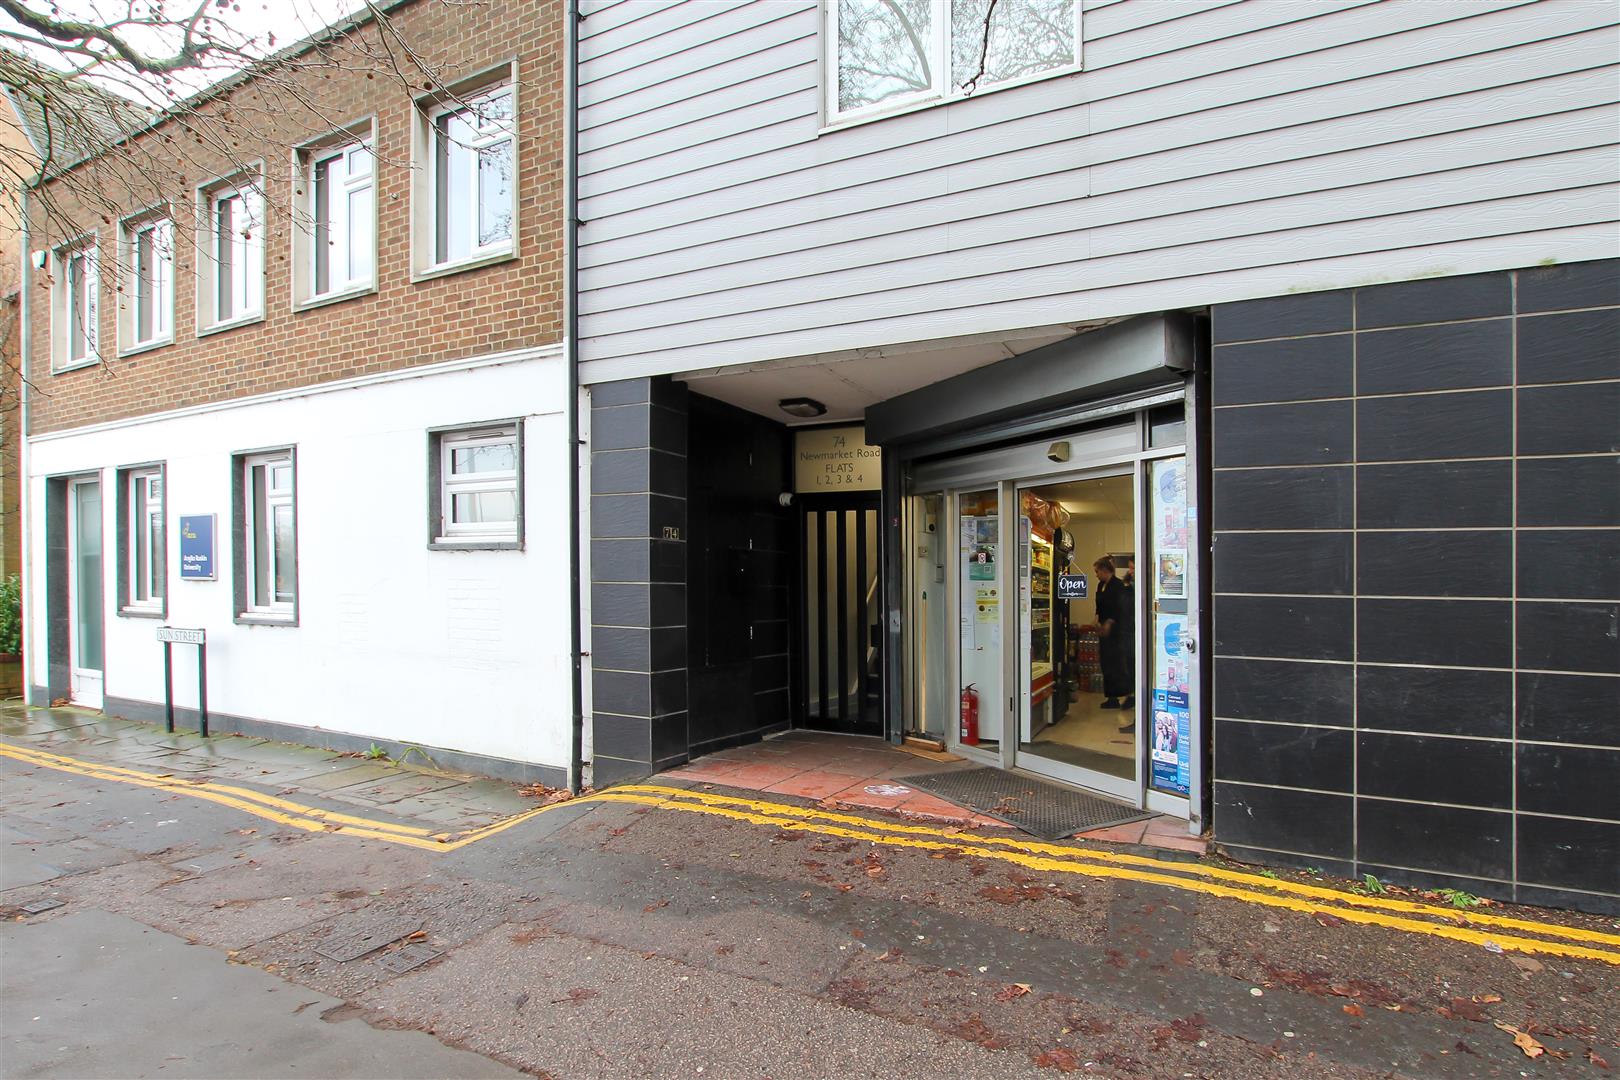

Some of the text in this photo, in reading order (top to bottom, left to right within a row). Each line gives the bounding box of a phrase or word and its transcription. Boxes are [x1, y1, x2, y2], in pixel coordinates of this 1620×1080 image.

[832, 436, 846, 448] 74
[800, 448, 881, 461] Newmarket Road
[825, 462, 854, 473] FLATS
[836, 474, 842, 484] 3
[845, 474, 853, 483] &
[857, 474, 864, 483] 4
[664, 528, 678, 539] 74
[1059, 577, 1087, 592] Open
[159, 630, 202, 642] SUN STREET
